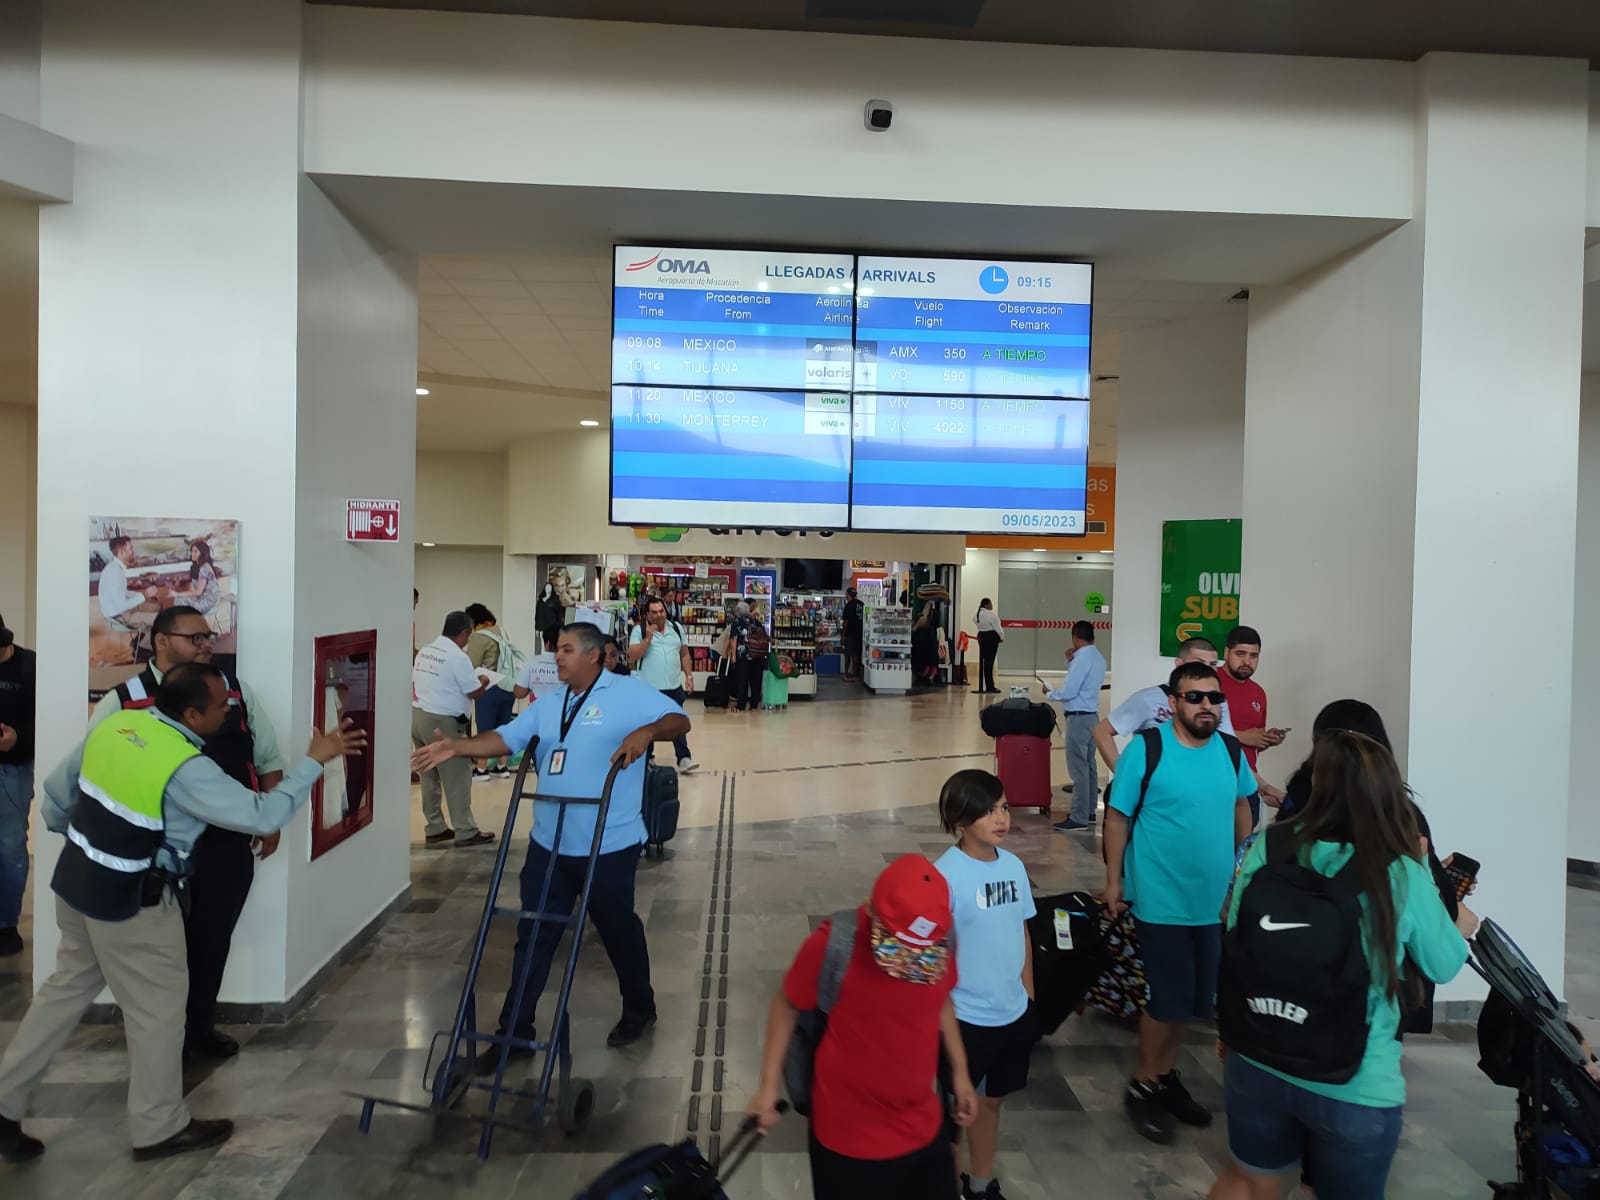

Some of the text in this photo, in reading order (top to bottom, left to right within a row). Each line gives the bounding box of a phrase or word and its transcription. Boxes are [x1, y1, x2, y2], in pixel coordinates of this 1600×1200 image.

[657, 259, 710, 273] OMA
[765, 265, 845, 279] LLEGADAS
[862, 269, 936, 283] ARRIVALS
[1017, 276, 1052, 288] 09:15
[639, 290, 665, 301] Hora
[706, 292, 771, 305] Procedencia
[915, 301, 944, 312] Vuelo
[639, 306, 664, 317] Time
[725, 309, 752, 320] From
[915, 316, 943, 328] Flight
[1010, 320, 1050, 331] Remark
[627, 336, 662, 348] 09:08
[683, 338, 737, 351] MEXICO
[889, 346, 919, 358] AMX
[944, 348, 967, 359] 350
[982, 349, 992, 359] A
[995, 349, 1047, 361] TIEMPO
[807, 366, 852, 378] volaris
[682, 391, 736, 404] MEXICO
[888, 396, 910, 409] VIV
[936, 399, 965, 410] 1150
[681, 414, 769, 428] MONTERREY
[350, 500, 397, 510] HIDRANTE
[1002, 514, 1076, 528] 09/05/2023
[1180, 595, 1238, 620] SUB
[985, 880, 1019, 908] NIKE
